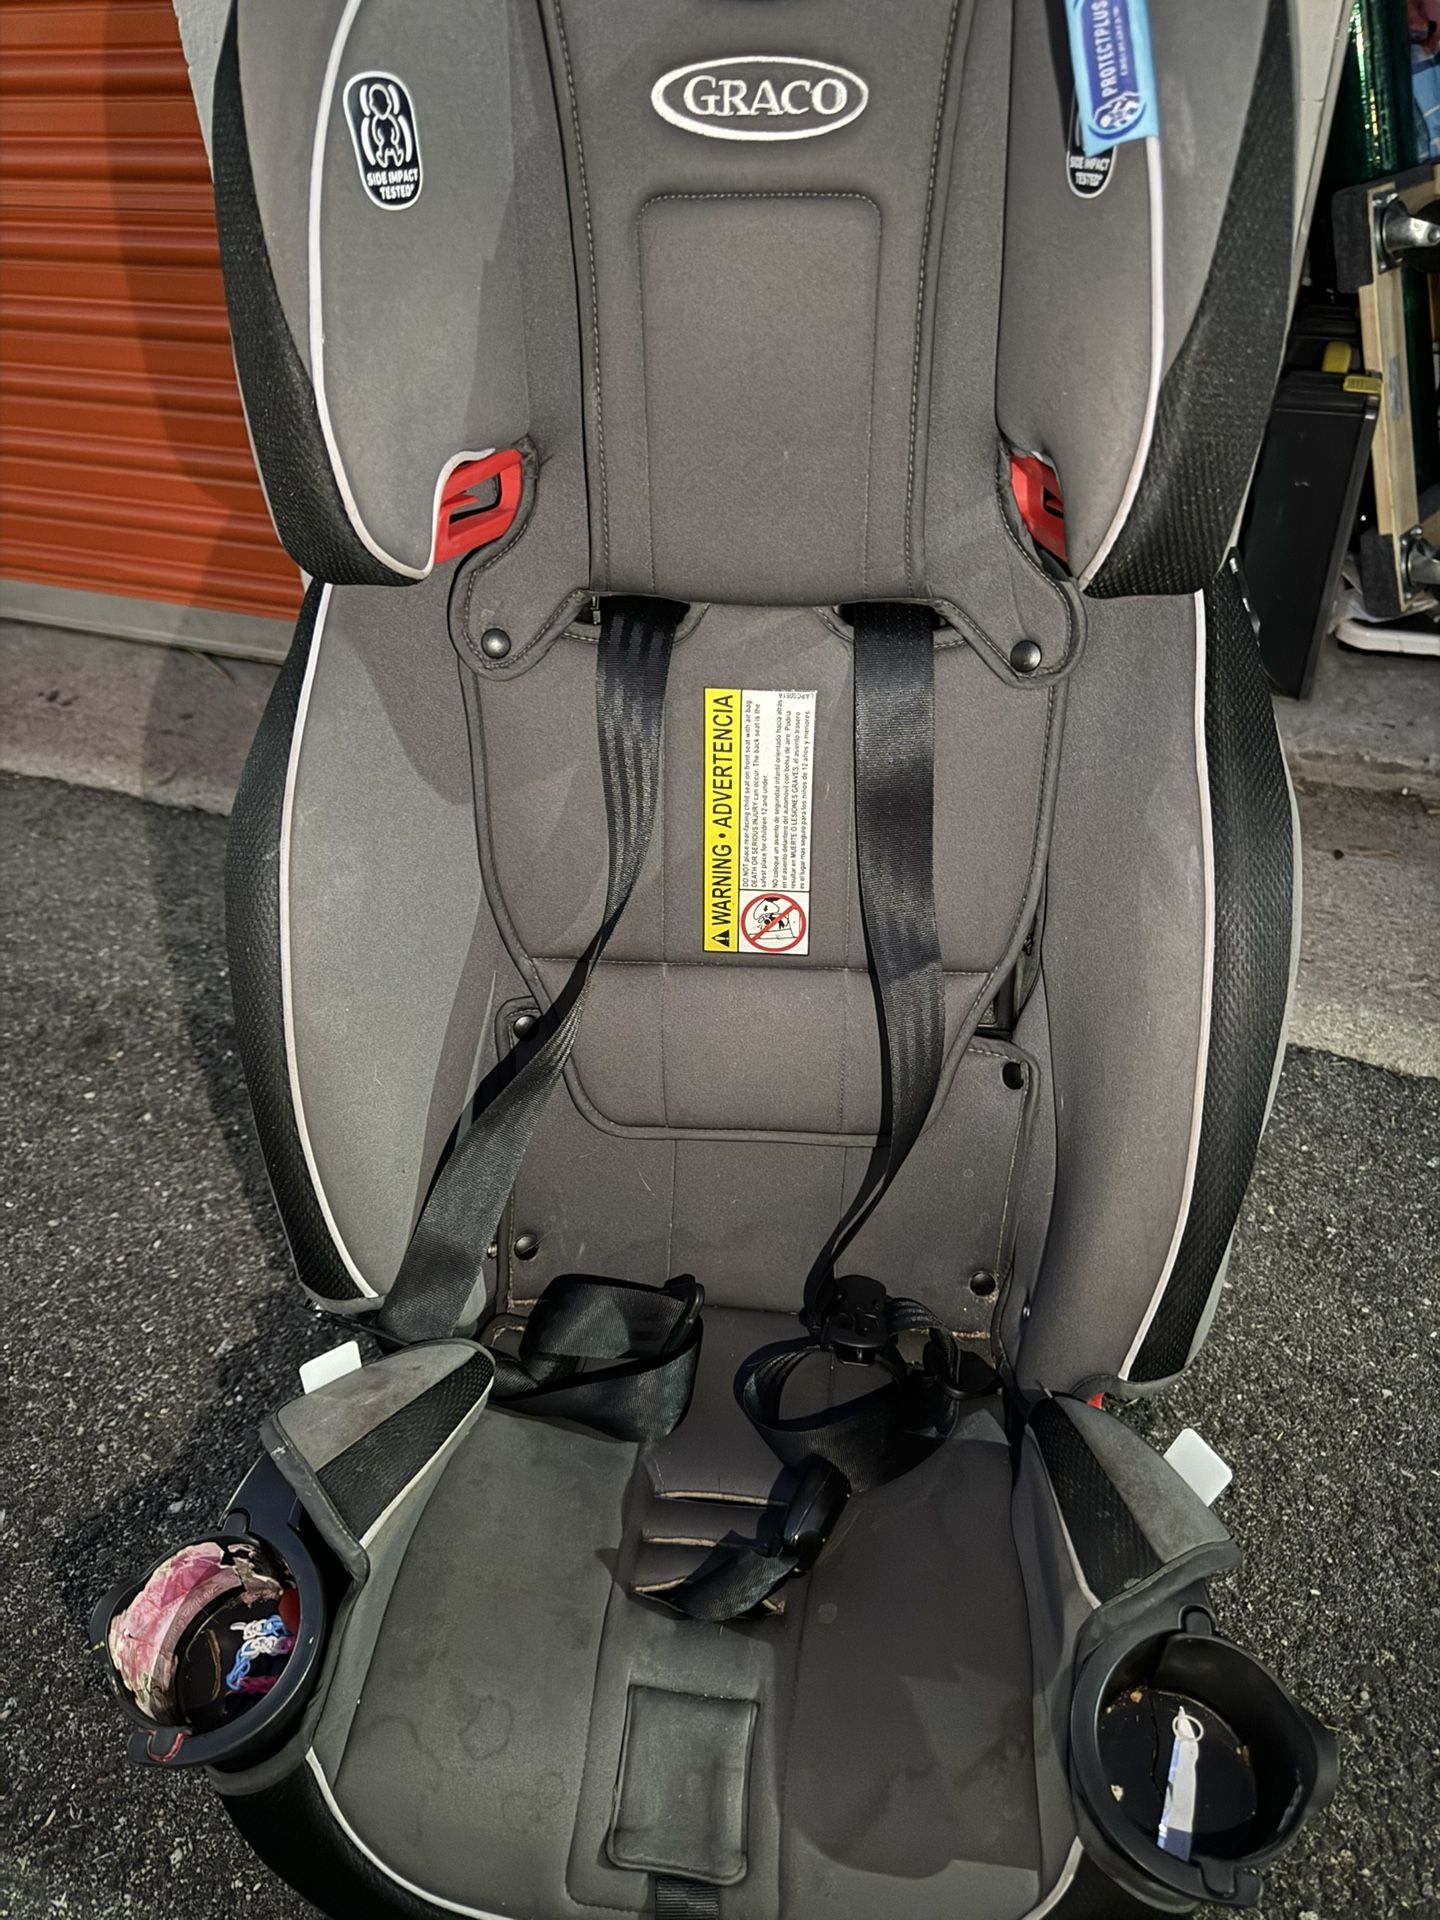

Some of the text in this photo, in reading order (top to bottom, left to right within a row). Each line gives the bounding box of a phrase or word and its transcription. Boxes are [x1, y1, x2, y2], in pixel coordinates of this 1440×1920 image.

[1091, 0, 1118, 98] PROTECTPLUS
[684, 75, 848, 117] GRACO
[367, 169, 418, 187] SIDE IMPACT
[712, 696, 733, 925] WARNING ADVERTENCIA
[751, 856, 758, 865] OR
[742, 878, 749, 887] DO
[772, 879, 778, 888] NO
